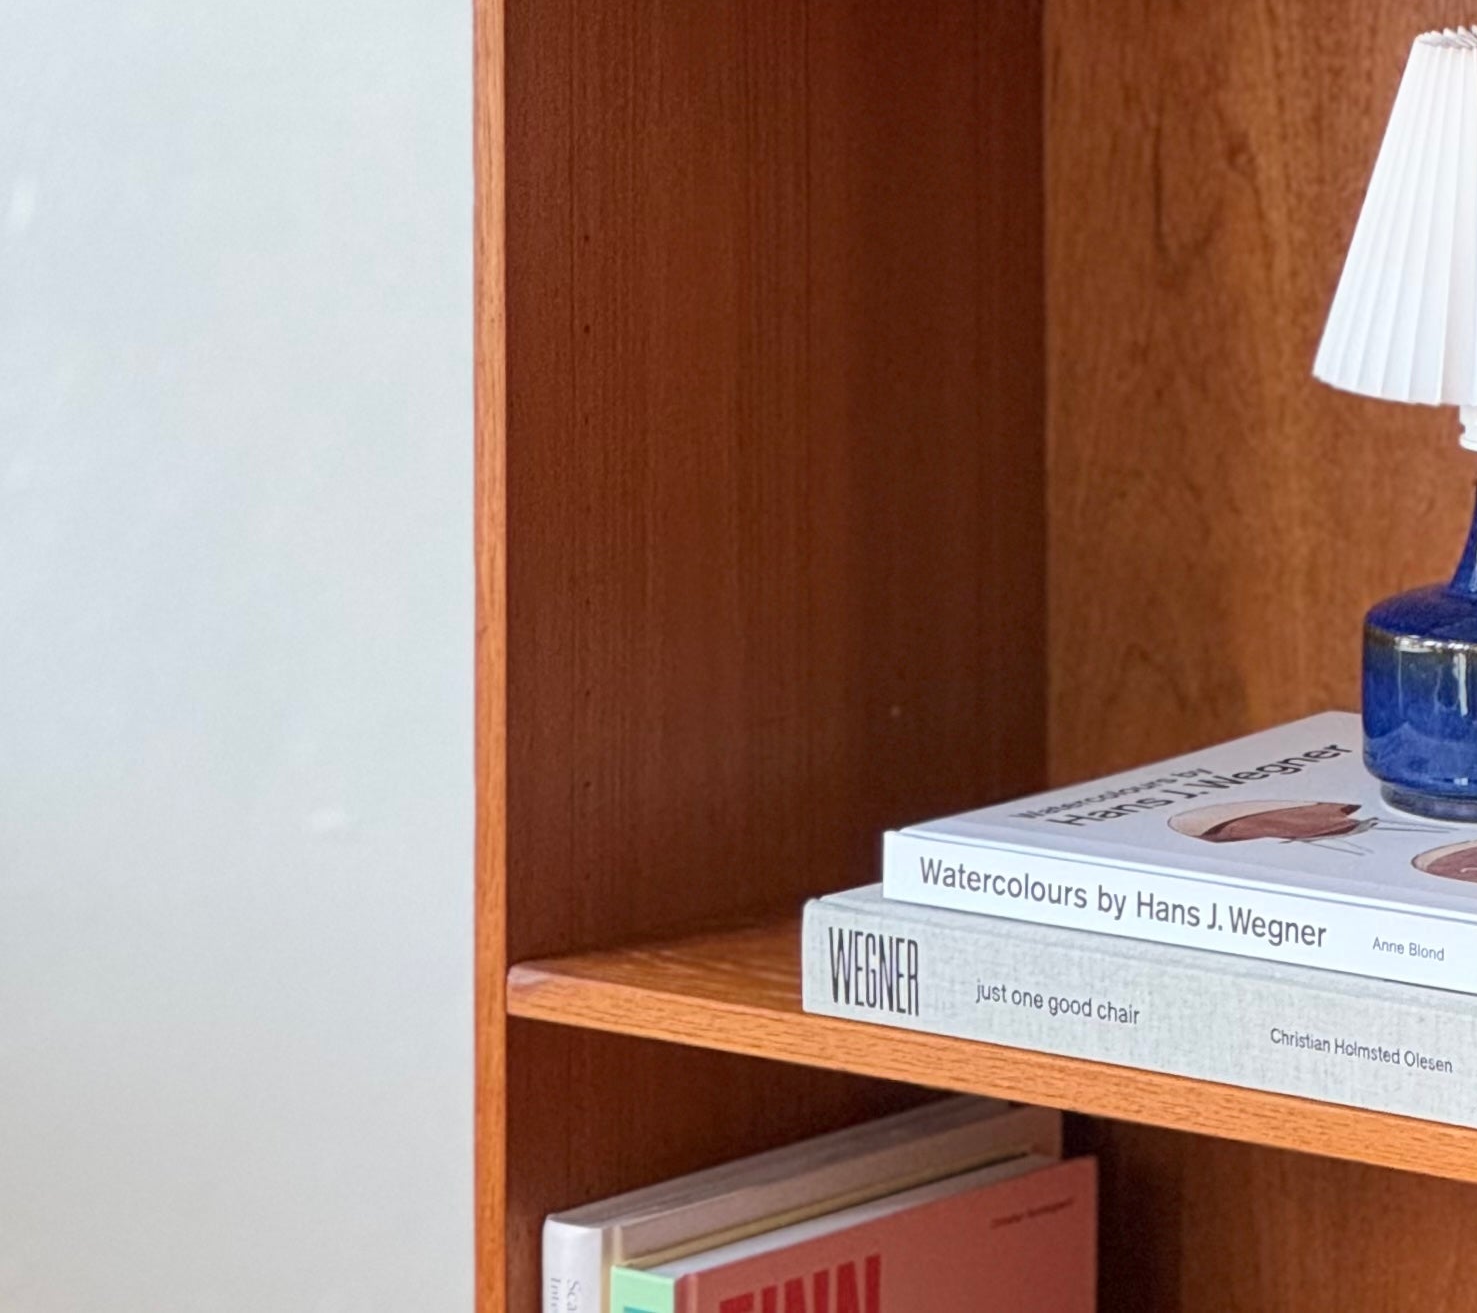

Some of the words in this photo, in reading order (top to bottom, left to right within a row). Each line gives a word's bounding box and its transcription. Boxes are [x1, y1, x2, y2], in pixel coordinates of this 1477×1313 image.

[1046, 796, 1174, 827] Hans
[1183, 743, 1353, 789] Wegner
[920, 856, 1088, 909] Watercolours
[1098, 884, 1127, 921] by
[1136, 890, 1201, 927] Hans
[1229, 905, 1327, 948] Wegner
[828, 926, 920, 1017] WEGNER
[1372, 936, 1405, 955] Anne
[1408, 941, 1445, 962] Blond
[975, 980, 1007, 1005] just
[1011, 990, 1044, 1010] one
[1048, 996, 1092, 1017] good
[1096, 1000, 1140, 1025] chair
[1270, 1027, 1331, 1054] Christian
[1334, 1037, 1401, 1066] Holmsted
[1404, 1050, 1454, 1074] Olesen
